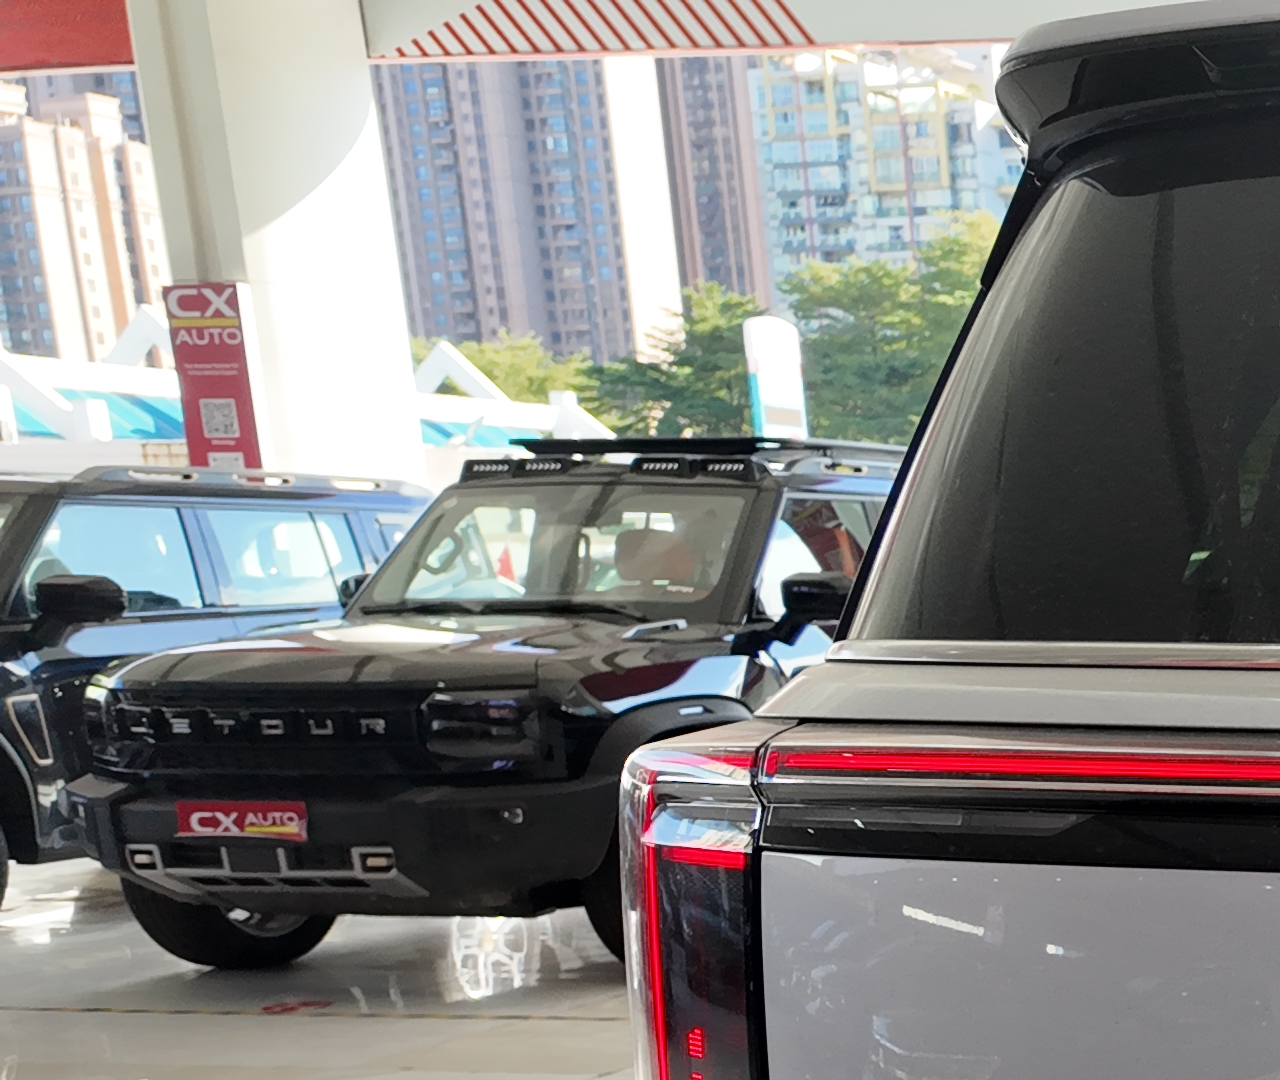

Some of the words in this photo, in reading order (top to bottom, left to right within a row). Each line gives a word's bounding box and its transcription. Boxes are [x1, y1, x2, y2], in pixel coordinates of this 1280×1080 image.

[167, 287, 237, 318] CX
[175, 328, 242, 346] AUTO
[189, 811, 241, 833] CX
[244, 811, 299, 827] AUTO
